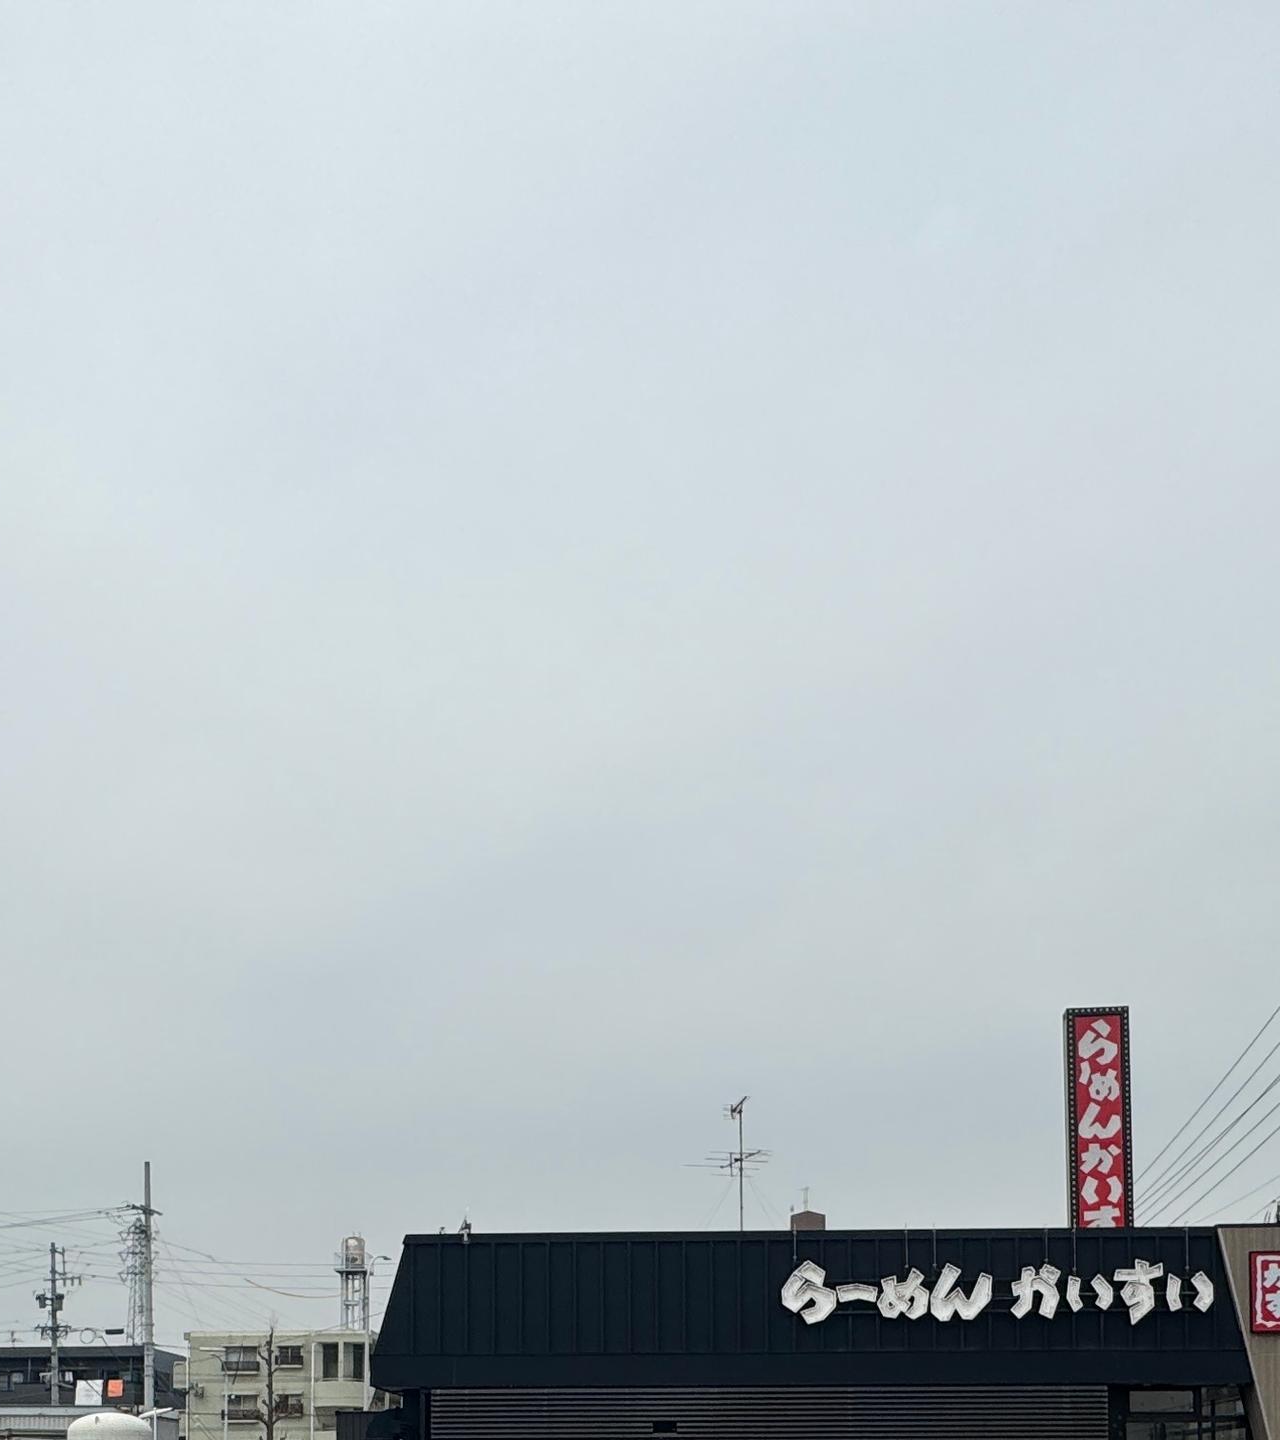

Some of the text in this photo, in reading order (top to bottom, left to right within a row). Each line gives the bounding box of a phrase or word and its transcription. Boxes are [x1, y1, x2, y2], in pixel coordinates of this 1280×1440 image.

[781, 1258, 1215, 1325] らーめん かいすい
